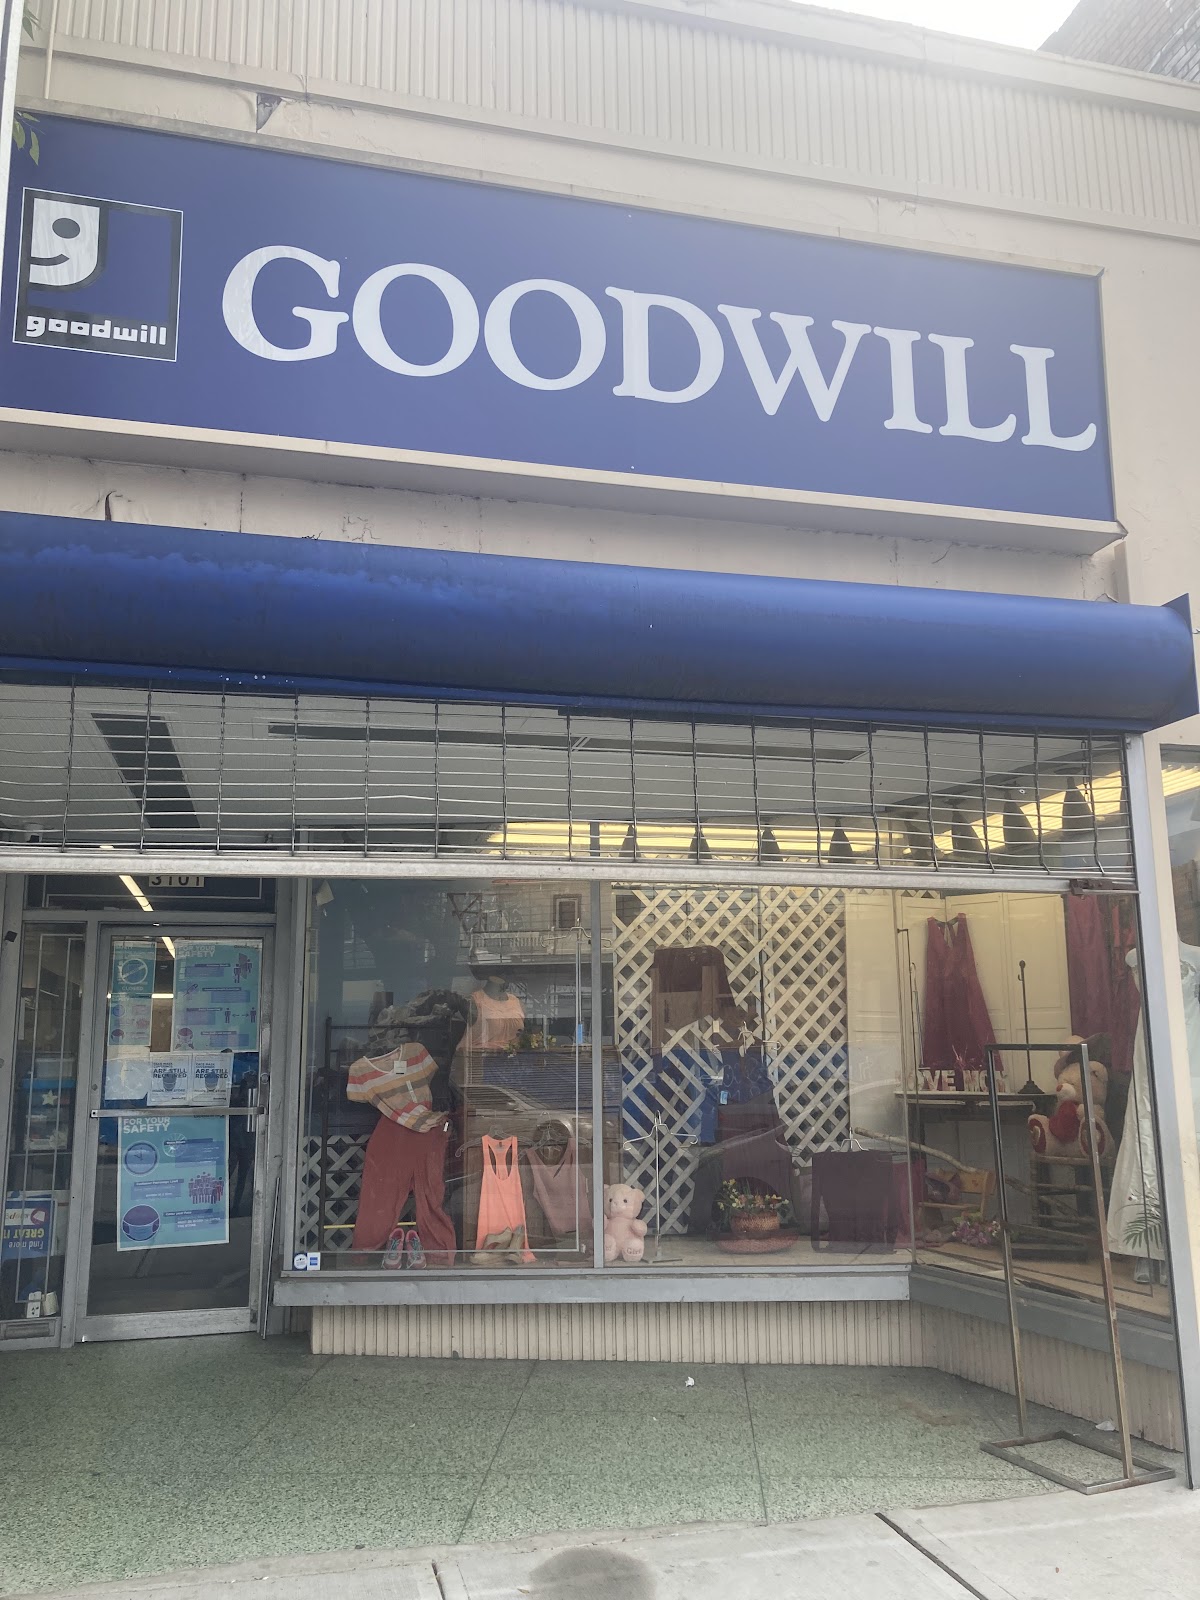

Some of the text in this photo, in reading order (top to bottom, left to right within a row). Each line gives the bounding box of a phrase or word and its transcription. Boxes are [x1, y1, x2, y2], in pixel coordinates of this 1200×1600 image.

[26, 315, 167, 345] goodwill
[222, 245, 1097, 452] GOODWILL
[144, 1116, 171, 1124] YOUR
[123, 1123, 171, 1134] SAFETY
[13, 1227, 45, 1239] GREAT
[8, 1240, 44, 1250] Find more
